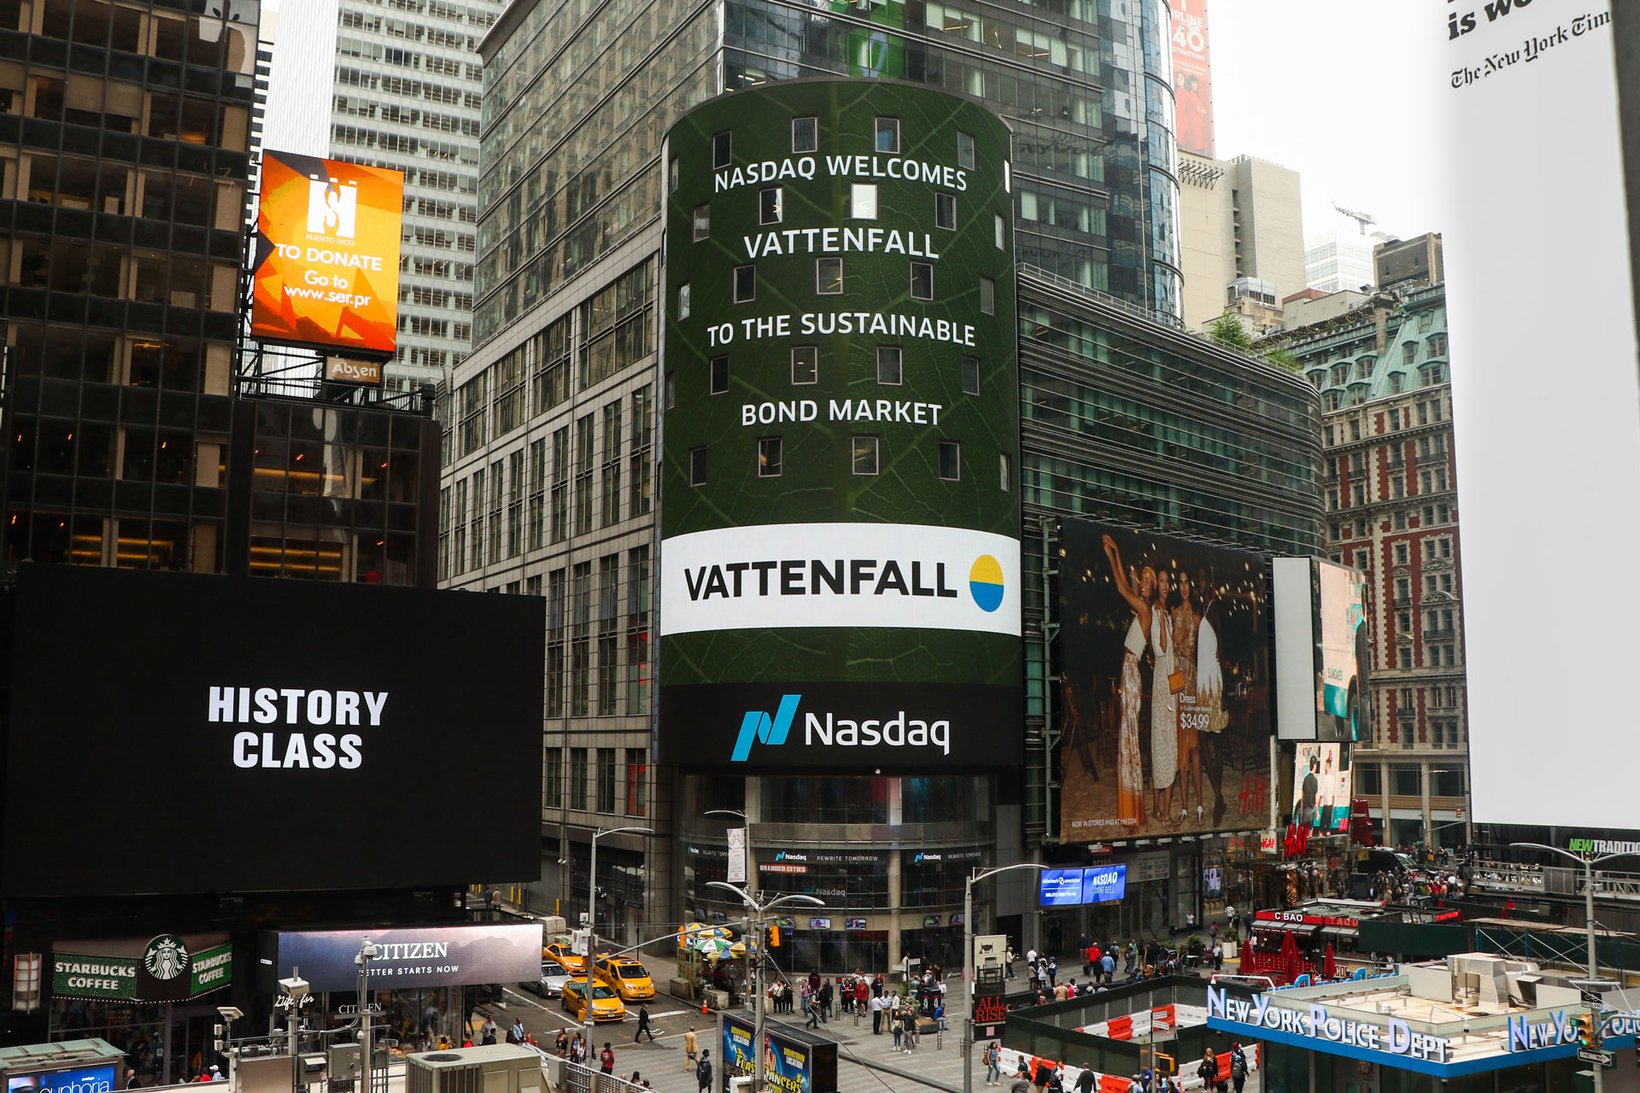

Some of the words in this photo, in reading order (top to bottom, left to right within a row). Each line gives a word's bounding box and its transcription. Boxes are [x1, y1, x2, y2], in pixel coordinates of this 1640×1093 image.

[1448, 12, 1477, 41] is
[1172, 24, 1206, 53] 40
[1451, 67, 1481, 88] The
[1484, 50, 1521, 78] New
[1523, 26, 1568, 62] York
[715, 156, 816, 193] NASDAQ
[826, 155, 968, 192] WELCOMES
[336, 239, 355, 247] RICO
[743, 227, 940, 259] VATTENFALL
[275, 243, 301, 260] TO
[306, 247, 383, 272] DONATE
[304, 269, 329, 287] Go
[333, 275, 349, 289] to
[284, 285, 372, 309] www.ser.pr
[707, 322, 734, 347] TO
[741, 314, 791, 340] THE
[800, 312, 976, 347] SUSTAINABLE
[332, 361, 377, 379] Absen
[742, 400, 818, 426] BOND
[829, 399, 943, 426] MARKET
[684, 559, 958, 601] VATTENFALL
[208, 686, 389, 726] HISTORY
[1179, 692, 1197, 704] Dress
[1180, 711, 1210, 729] $34.99
[805, 711, 950, 755] Nasdaq
[233, 731, 363, 770] CLASS
[1088, 819, 1105, 827] STORES
[1105, 818, 1115, 826] AND
[785, 853, 807, 862] Nasdaq
[760, 864, 786, 872] BRANDED
[786, 865, 807, 873] CITIES
[1092, 871, 1119, 886] NASDAQ
[1274, 912, 1281, 920] C
[1283, 912, 1303, 922] BAO
[371, 942, 449, 961] CITIZEN
[55, 963, 136, 978] STARBUCKS
[192, 952, 233, 974] STARBUCKS
[359, 968, 393, 977] ETTER
[397, 966, 433, 976] STARTS
[436, 965, 460, 974] NOW
[68, 977, 119, 991] COFFEE
[199, 967, 224, 985] COFFEE
[338, 1002, 382, 1015] CITEN
[979, 997, 1004, 1009] ALL
[975, 1007, 1007, 1022] RISE
[1207, 984, 1250, 1022] NEW
[1251, 993, 1306, 1035] YORK
[1309, 1003, 1384, 1050] POLICE
[1388, 1017, 1452, 1064] DEPT
[1508, 1014, 1549, 1053] NEW
